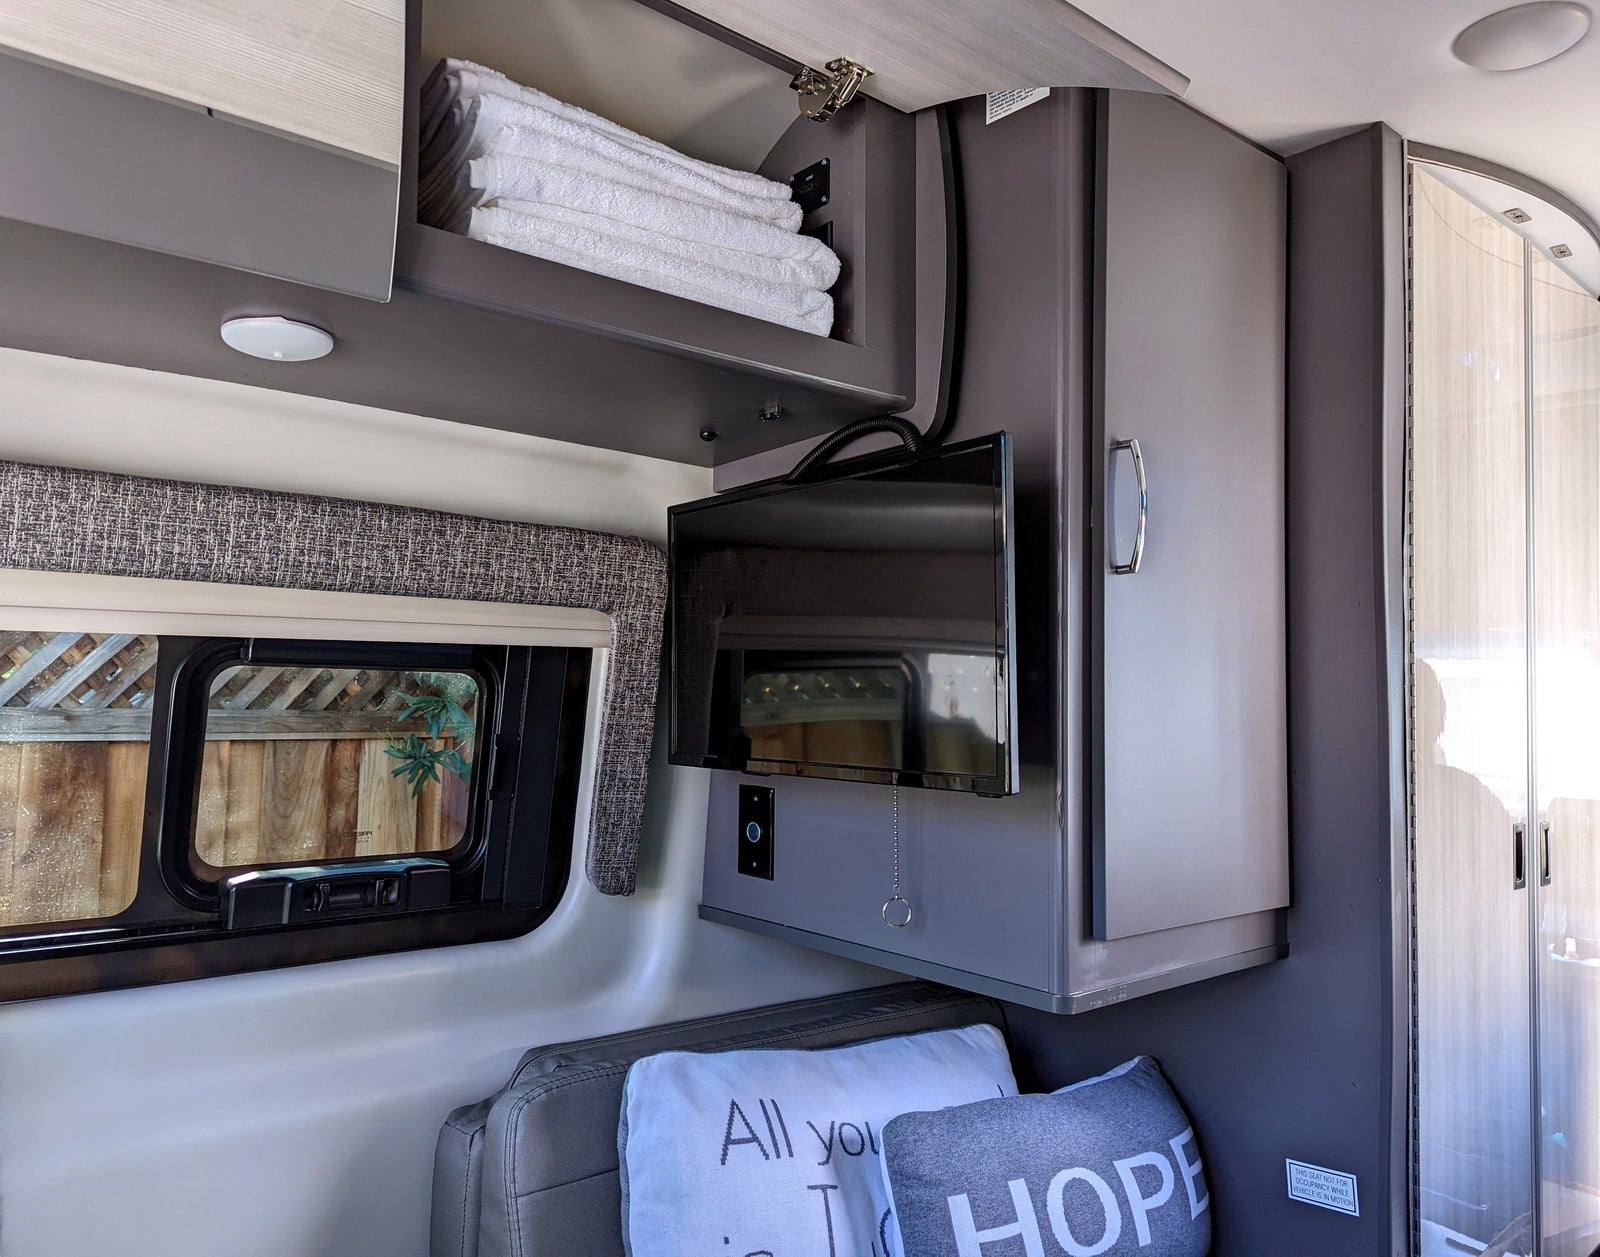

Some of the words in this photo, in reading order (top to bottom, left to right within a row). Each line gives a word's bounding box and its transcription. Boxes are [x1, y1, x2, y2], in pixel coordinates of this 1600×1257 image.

[721, 1099, 794, 1165] All
[1296, 1168, 1308, 1177] THIS
[1308, 1171, 1322, 1180] SEAT
[1324, 1175, 1336, 1184] NOT
[1336, 1178, 1348, 1188] FOR
[1296, 1177, 1330, 1191] OCCUPANCY
[1331, 1187, 1349, 1197] WHILE
[947, 1126, 1209, 1257] HOPE
[1293, 1186, 1315, 1198] VEHICLE
[1330, 1196, 1354, 1208] MOTION
